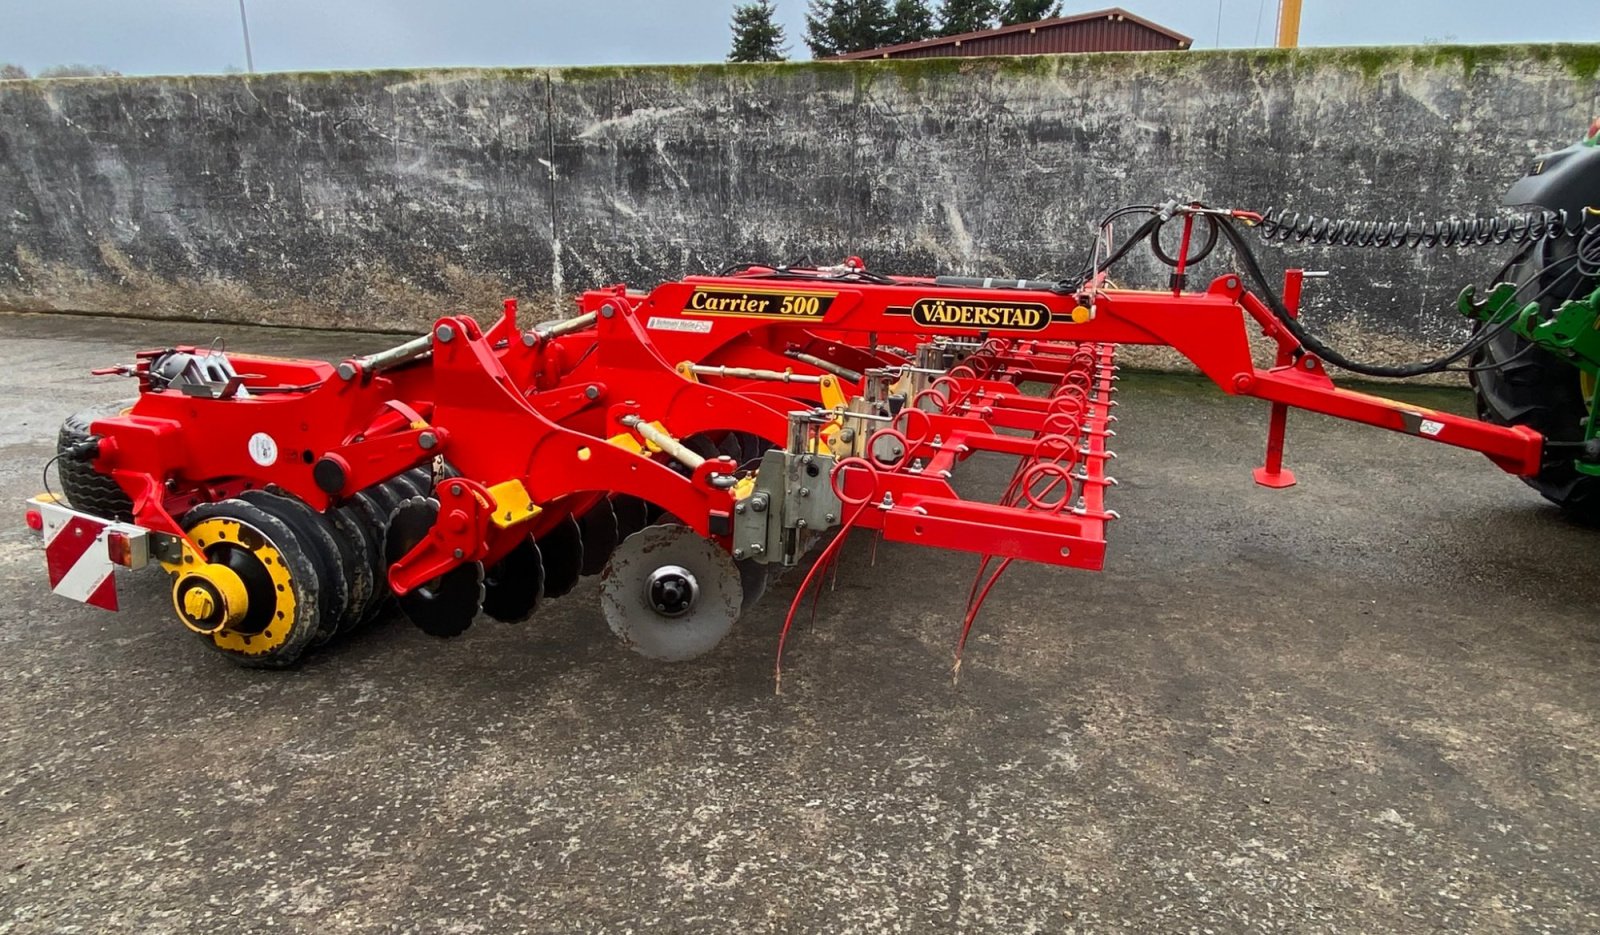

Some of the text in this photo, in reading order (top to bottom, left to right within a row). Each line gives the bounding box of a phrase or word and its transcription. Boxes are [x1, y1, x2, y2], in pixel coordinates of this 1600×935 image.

[691, 292, 820, 315] Carrier 500
[921, 301, 1041, 326] VÄDERSTAD
